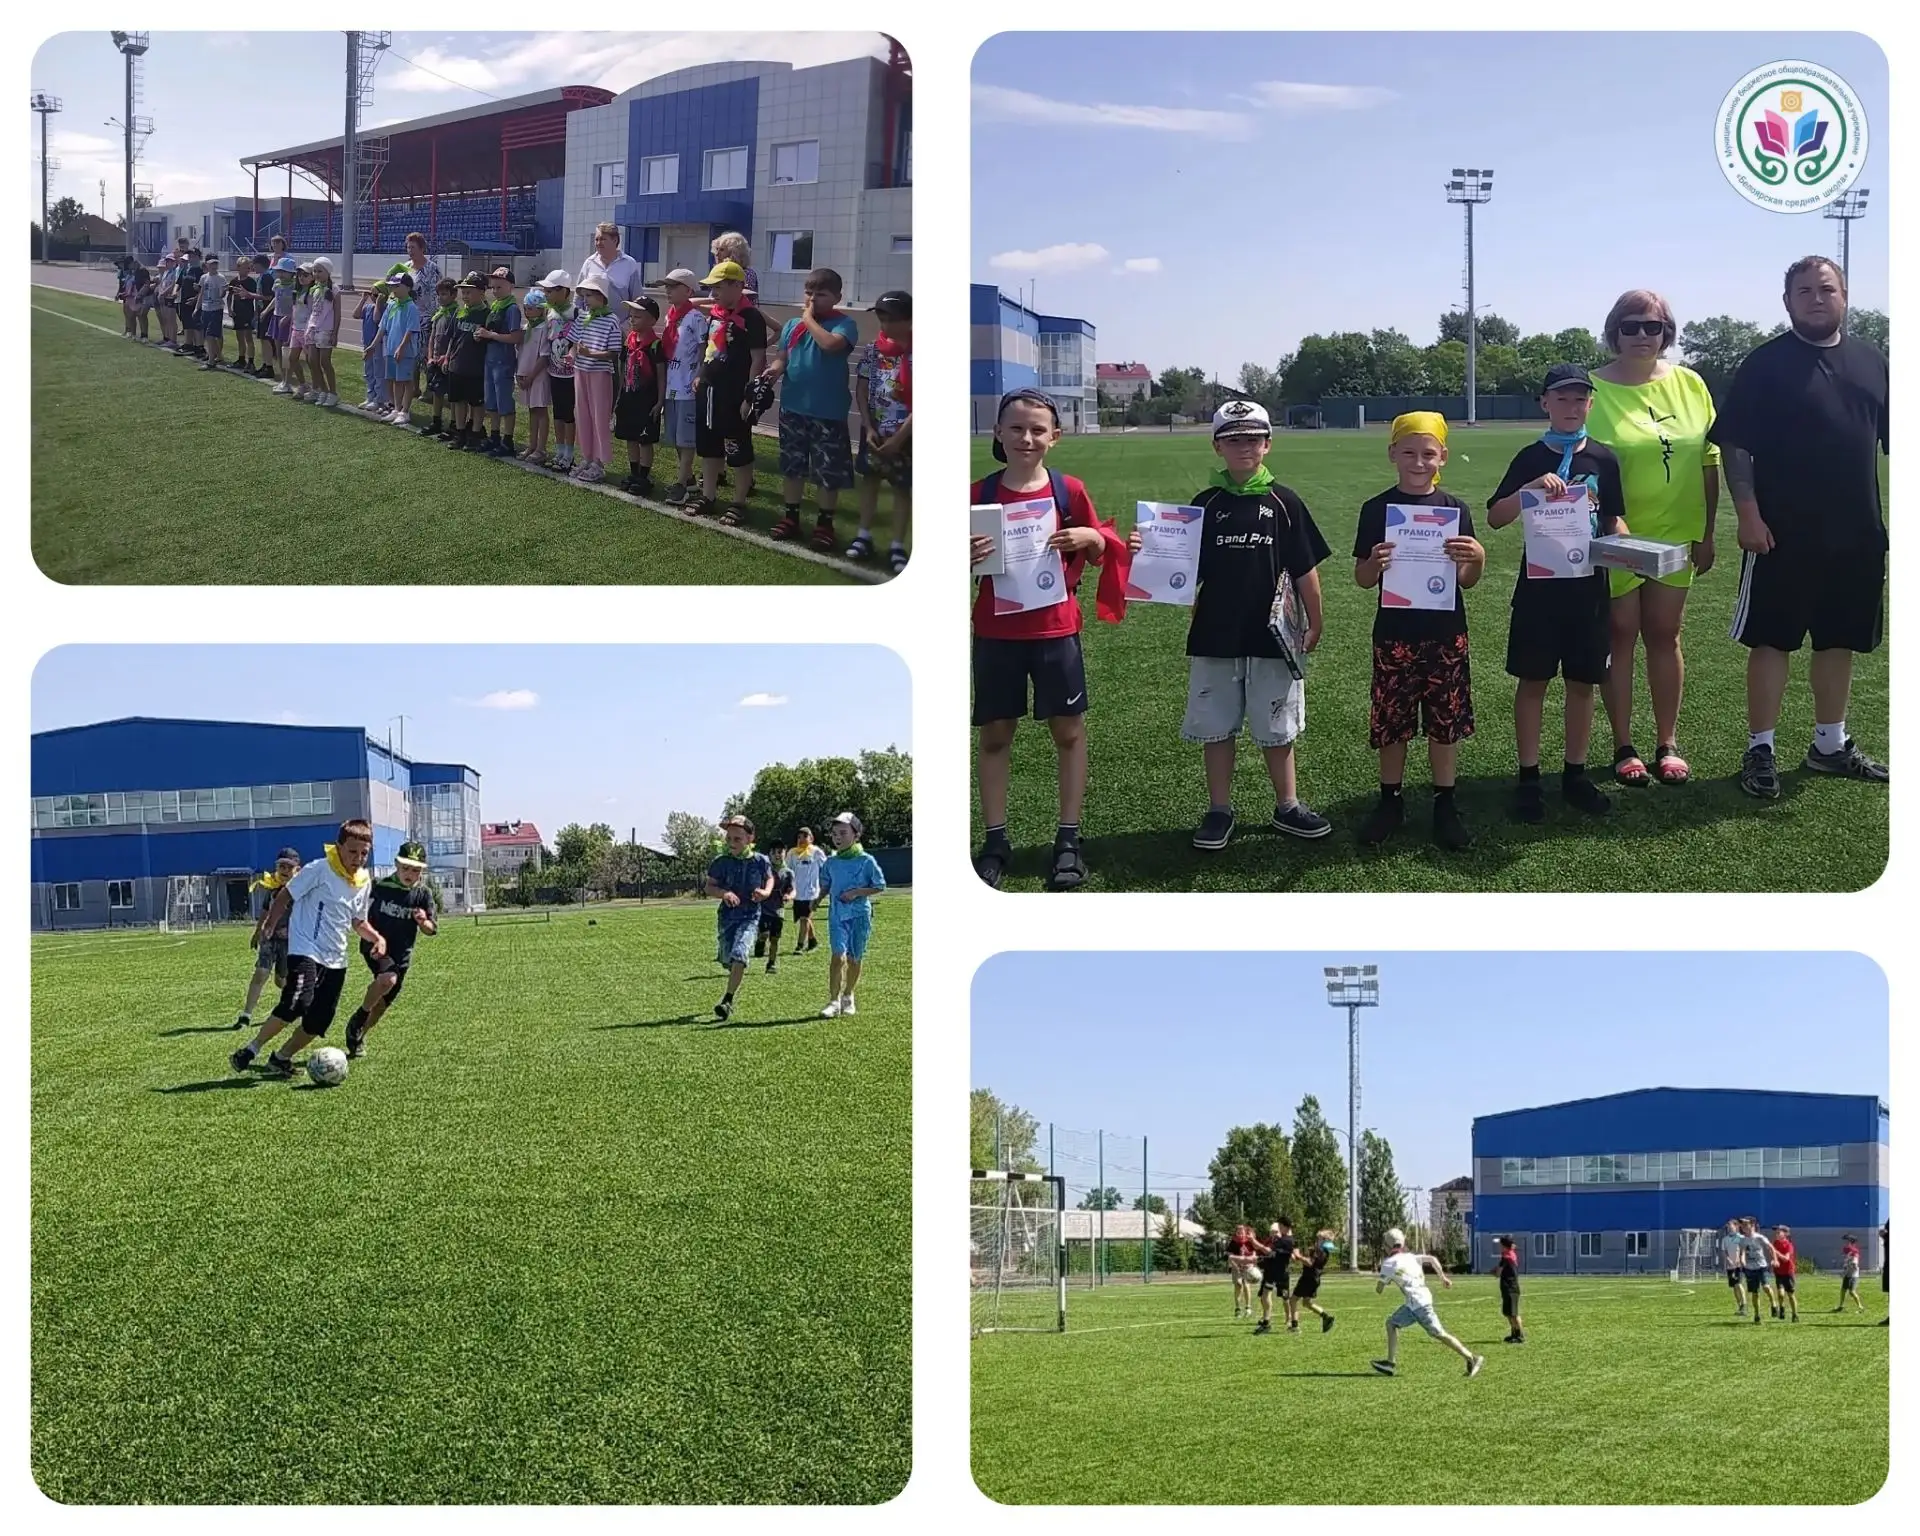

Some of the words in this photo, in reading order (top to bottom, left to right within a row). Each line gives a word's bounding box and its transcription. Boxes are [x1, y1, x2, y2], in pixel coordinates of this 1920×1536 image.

[1533, 507, 1577, 517] ГРАМОТА
[1148, 525, 1188, 536] ГРАМОТА
[1398, 529, 1443, 538] ГРАМОТА
[1249, 533, 1274, 545] Prix
